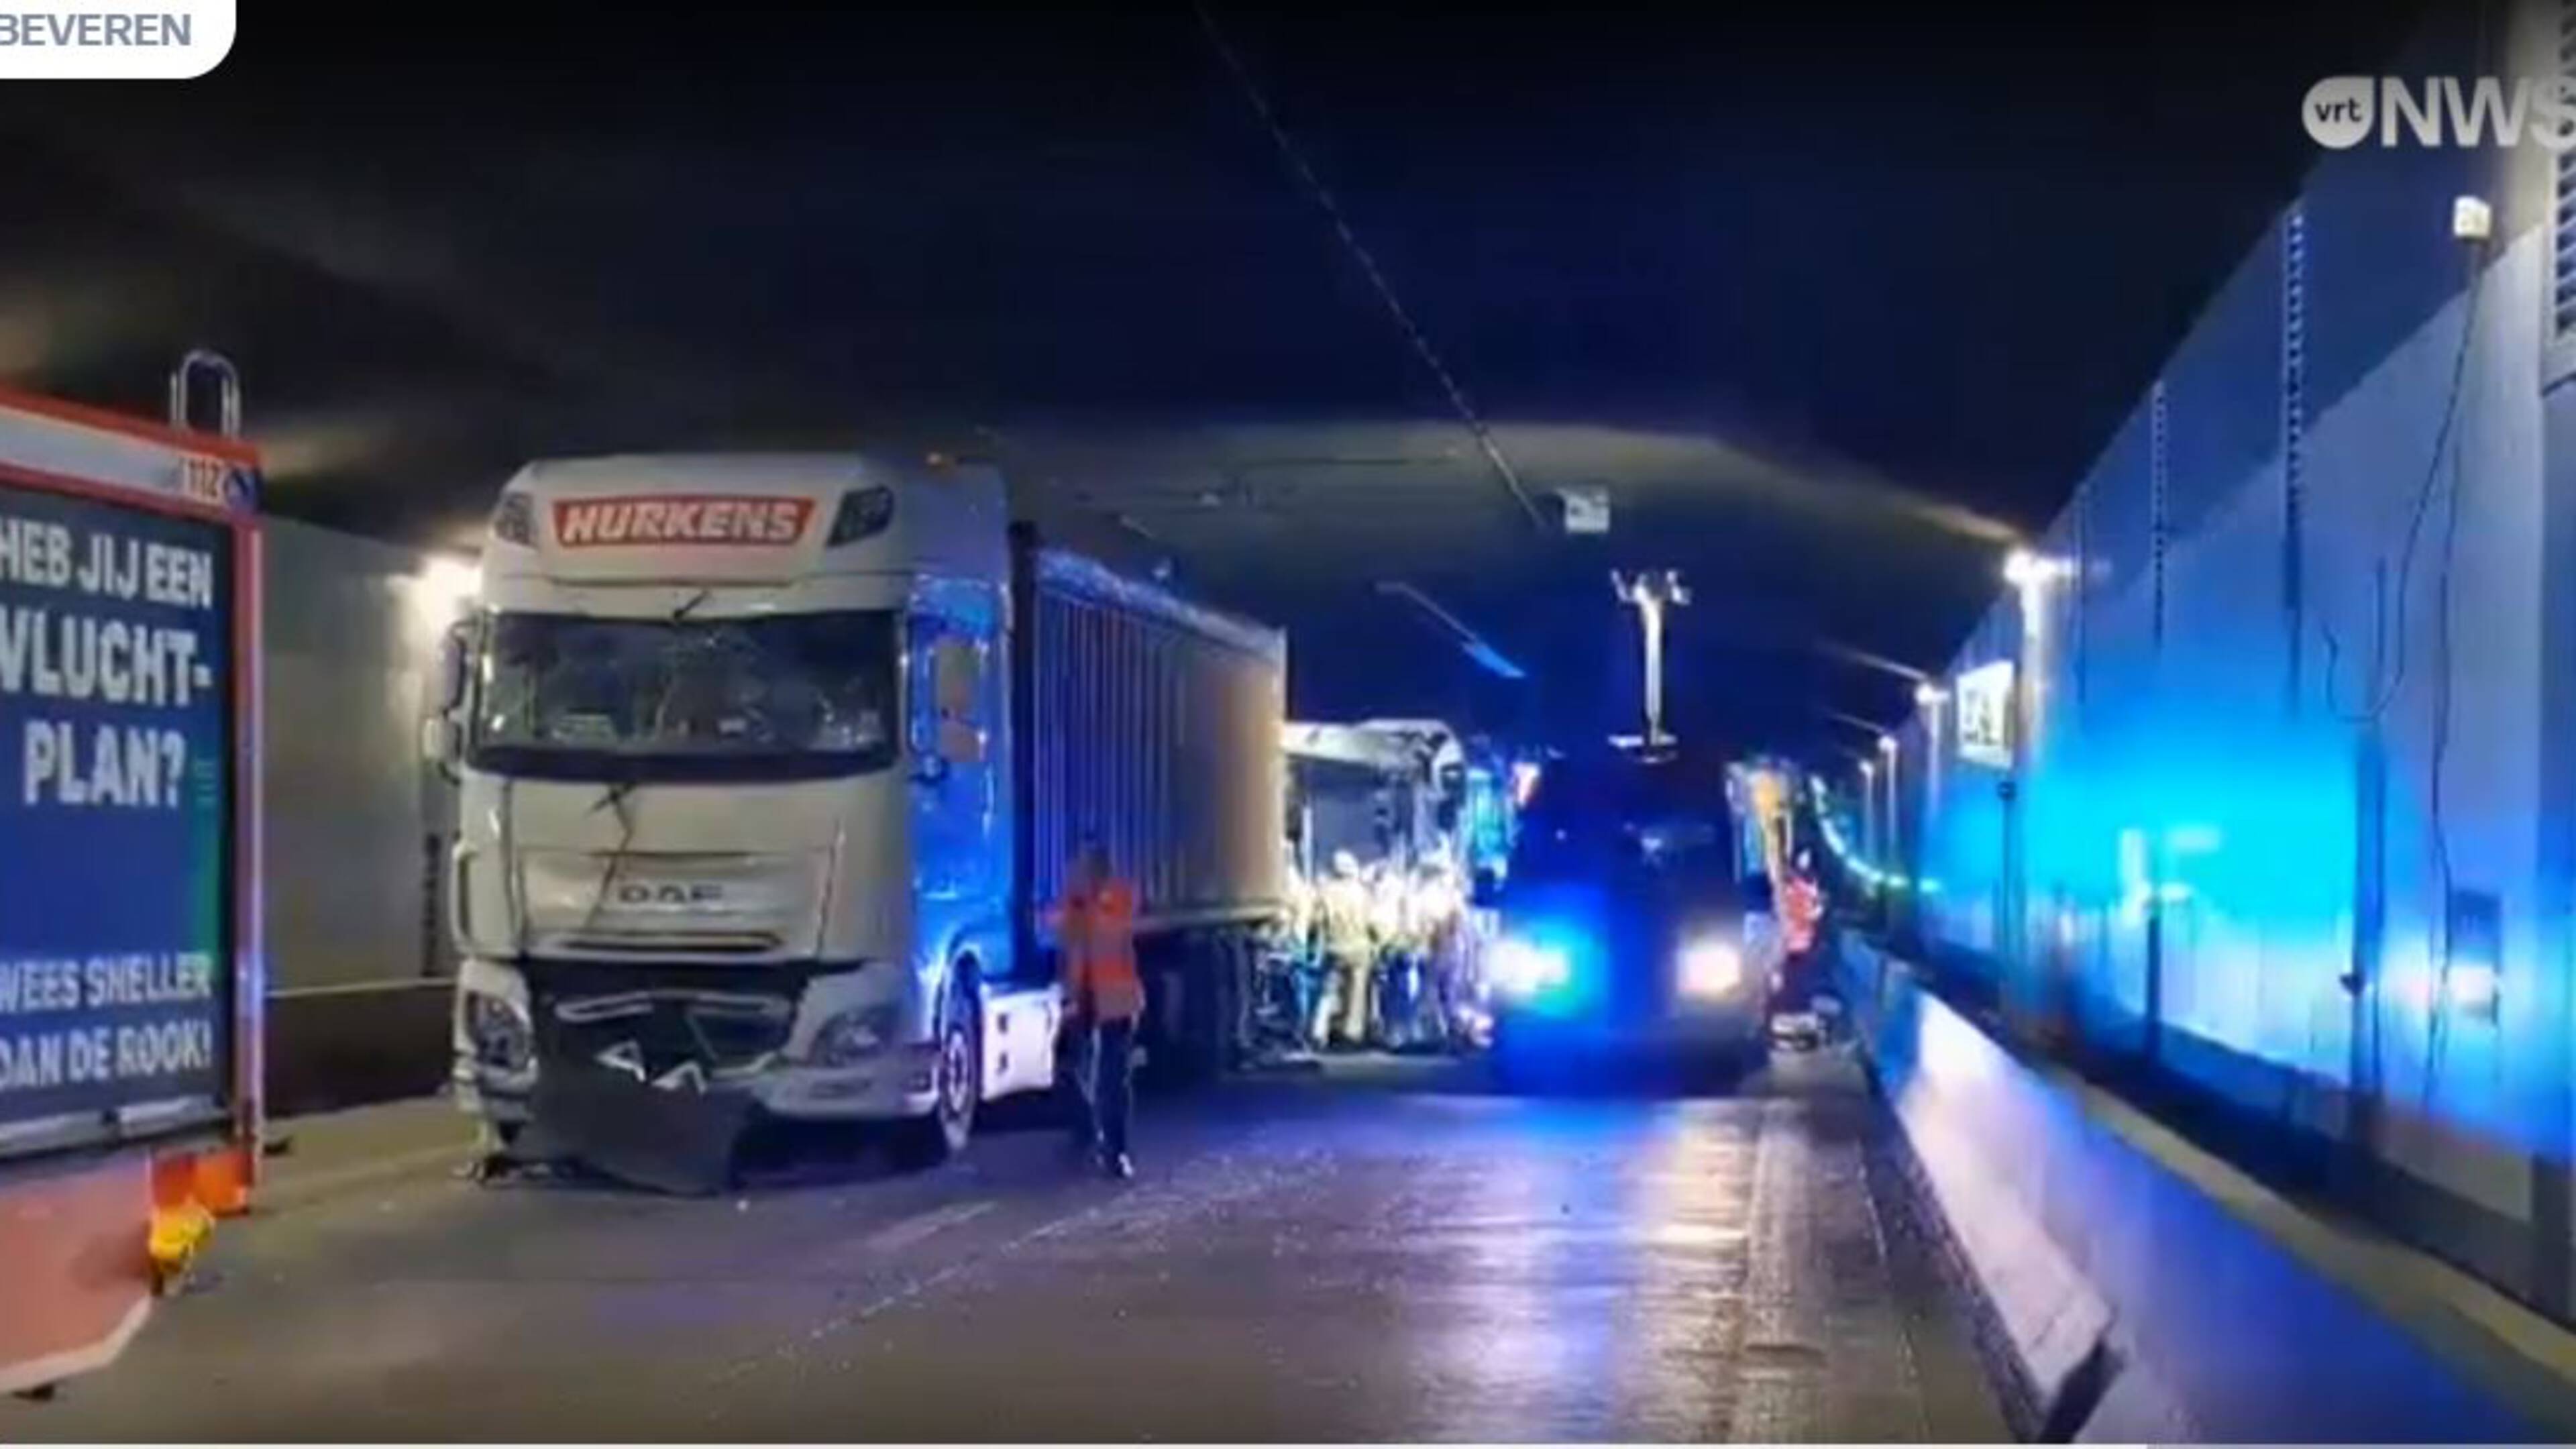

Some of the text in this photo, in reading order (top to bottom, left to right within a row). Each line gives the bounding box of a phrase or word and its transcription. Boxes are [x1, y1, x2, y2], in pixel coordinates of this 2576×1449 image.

[563, 500, 800, 543] HURKENS
[0, 518, 213, 609] HEB JIJ EEN
[0, 602, 211, 708] VLUCHT-
[25, 720, 185, 809] PLAN?
[619, 884, 723, 903] DAF
[0, 951, 212, 1013] WEES SNELLER
[68, 1027, 111, 1084] DE
[117, 1019, 211, 1077] ROOK!
